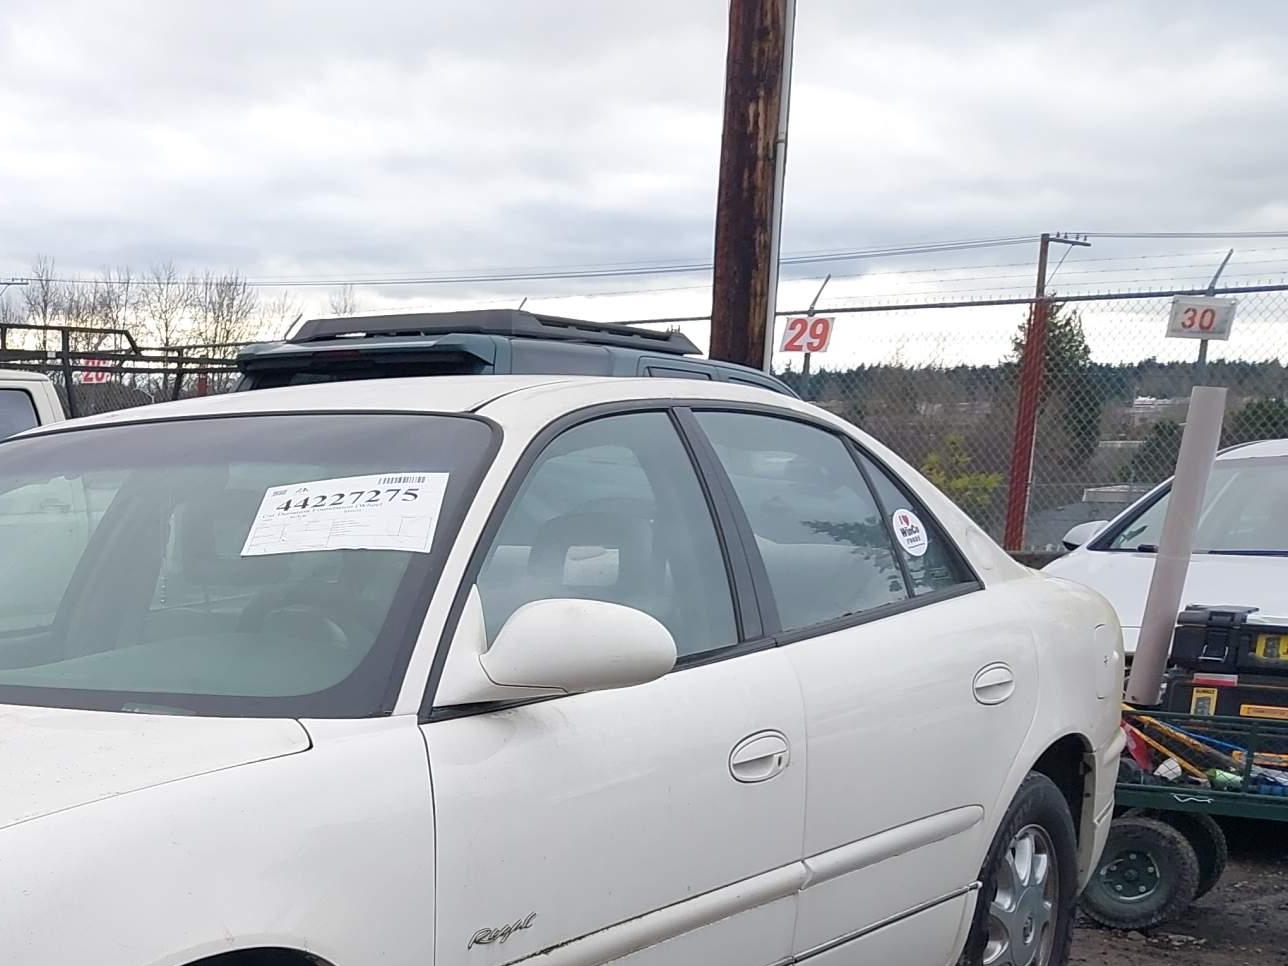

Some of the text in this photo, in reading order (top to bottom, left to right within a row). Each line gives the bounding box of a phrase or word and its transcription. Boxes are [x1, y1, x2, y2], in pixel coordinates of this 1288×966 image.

[1181, 307, 1216, 331] 30
[784, 318, 830, 352] 29
[276, 488, 420, 511] 44227275
[468, 911, 536, 950] Regal
